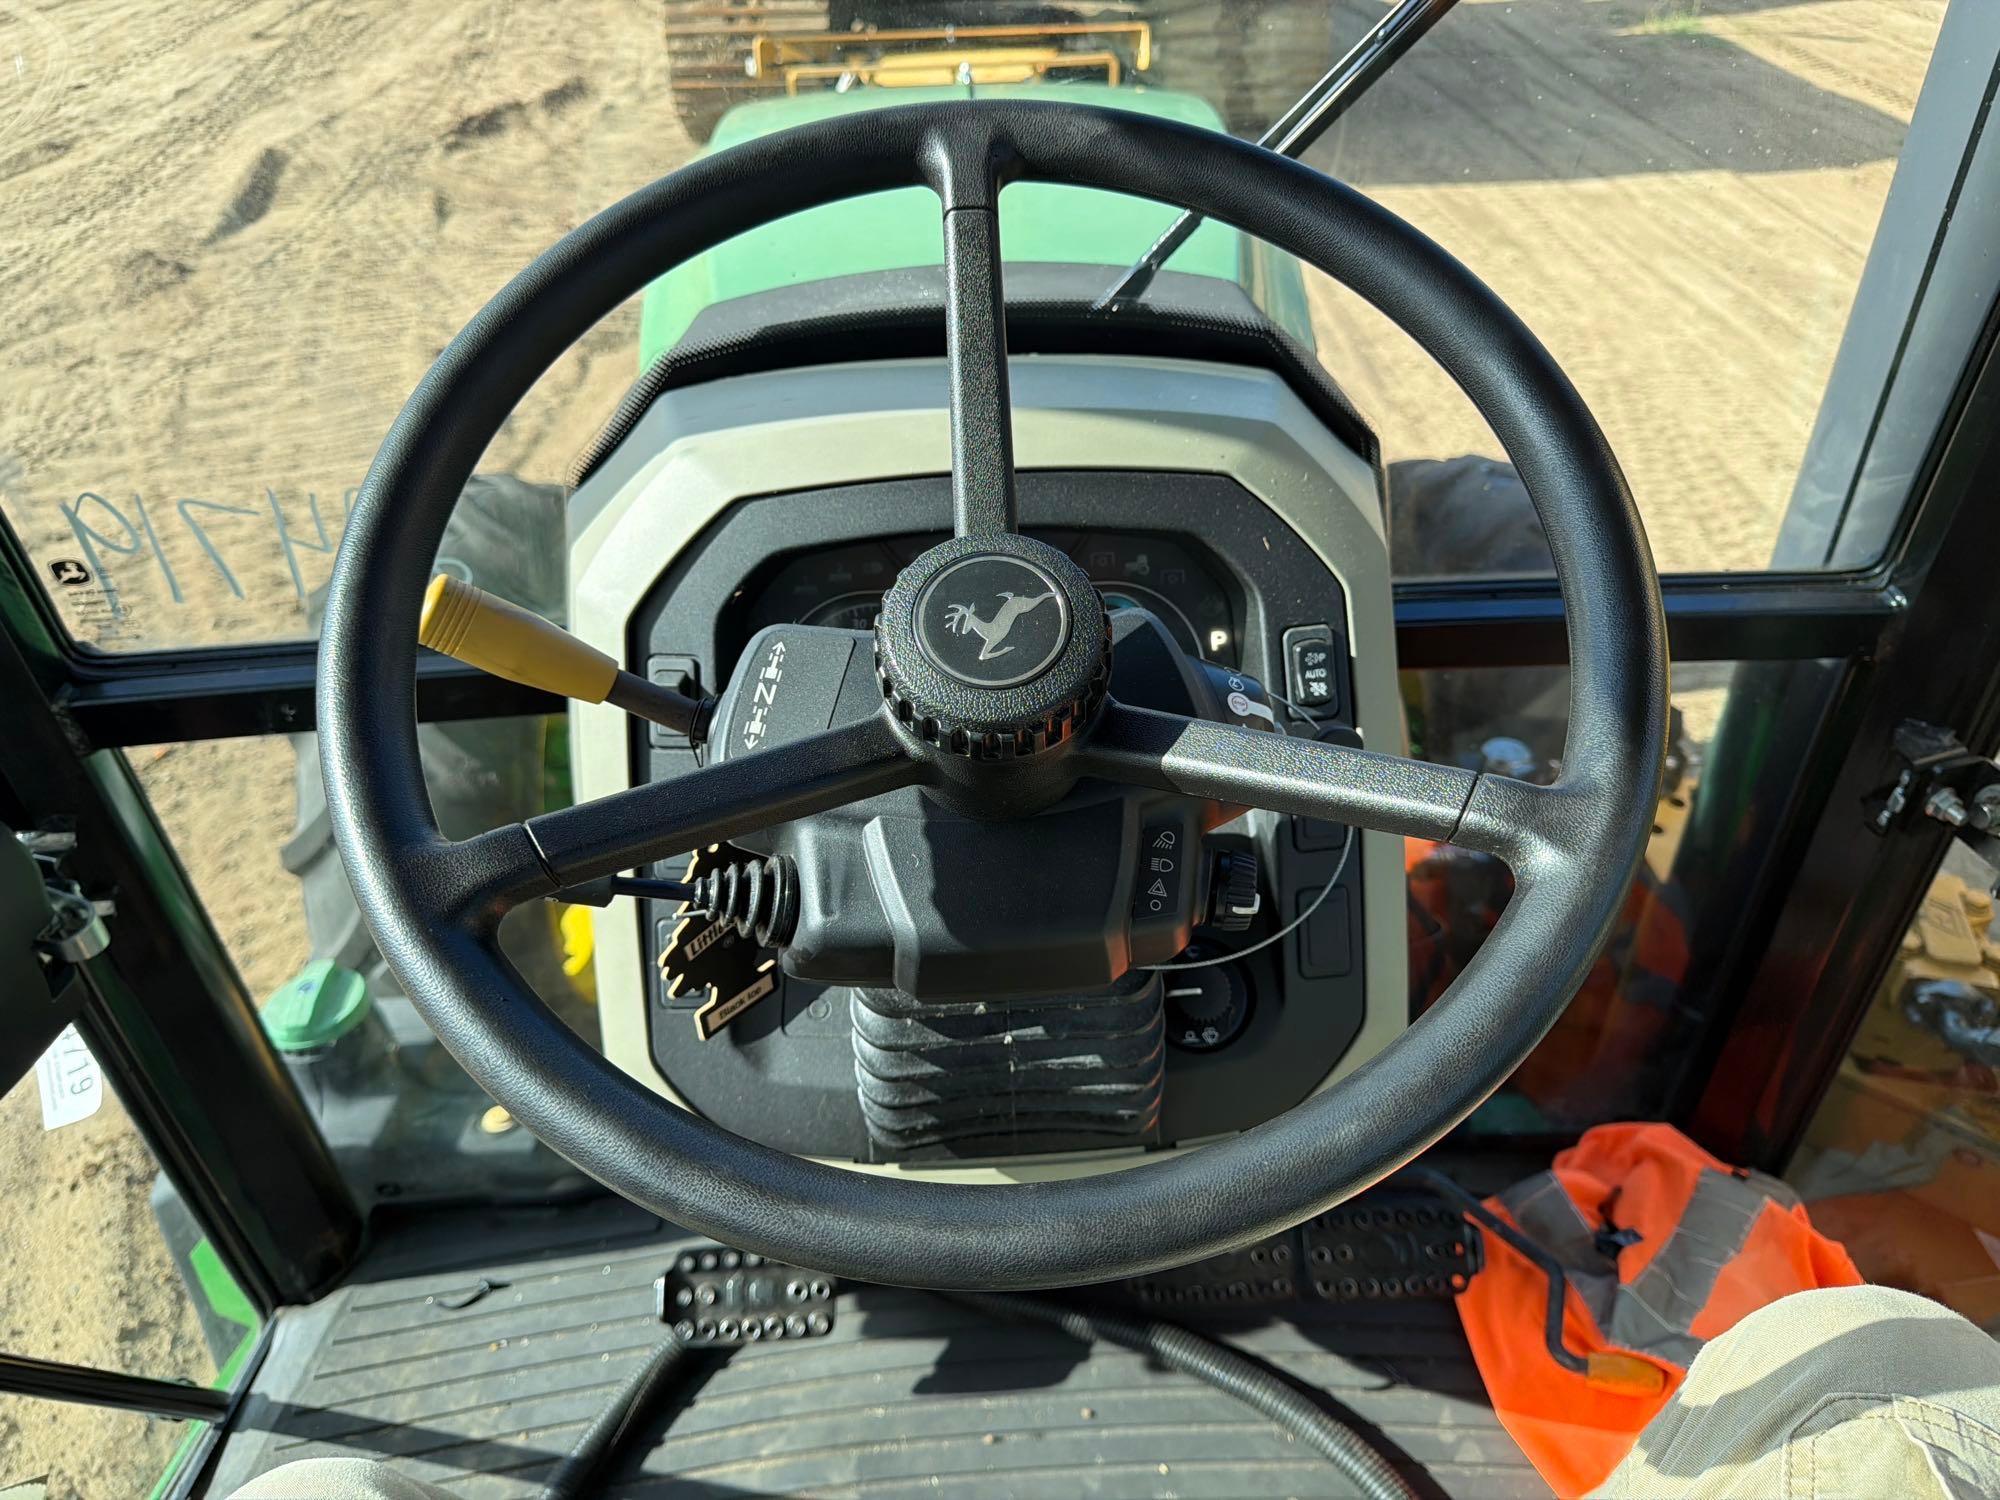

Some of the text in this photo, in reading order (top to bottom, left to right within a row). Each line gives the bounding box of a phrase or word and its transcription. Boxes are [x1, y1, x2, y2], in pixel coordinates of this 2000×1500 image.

[1210, 630, 1228, 652] P
[1304, 668, 1327, 679] AUTO
[753, 682, 778, 705] N
